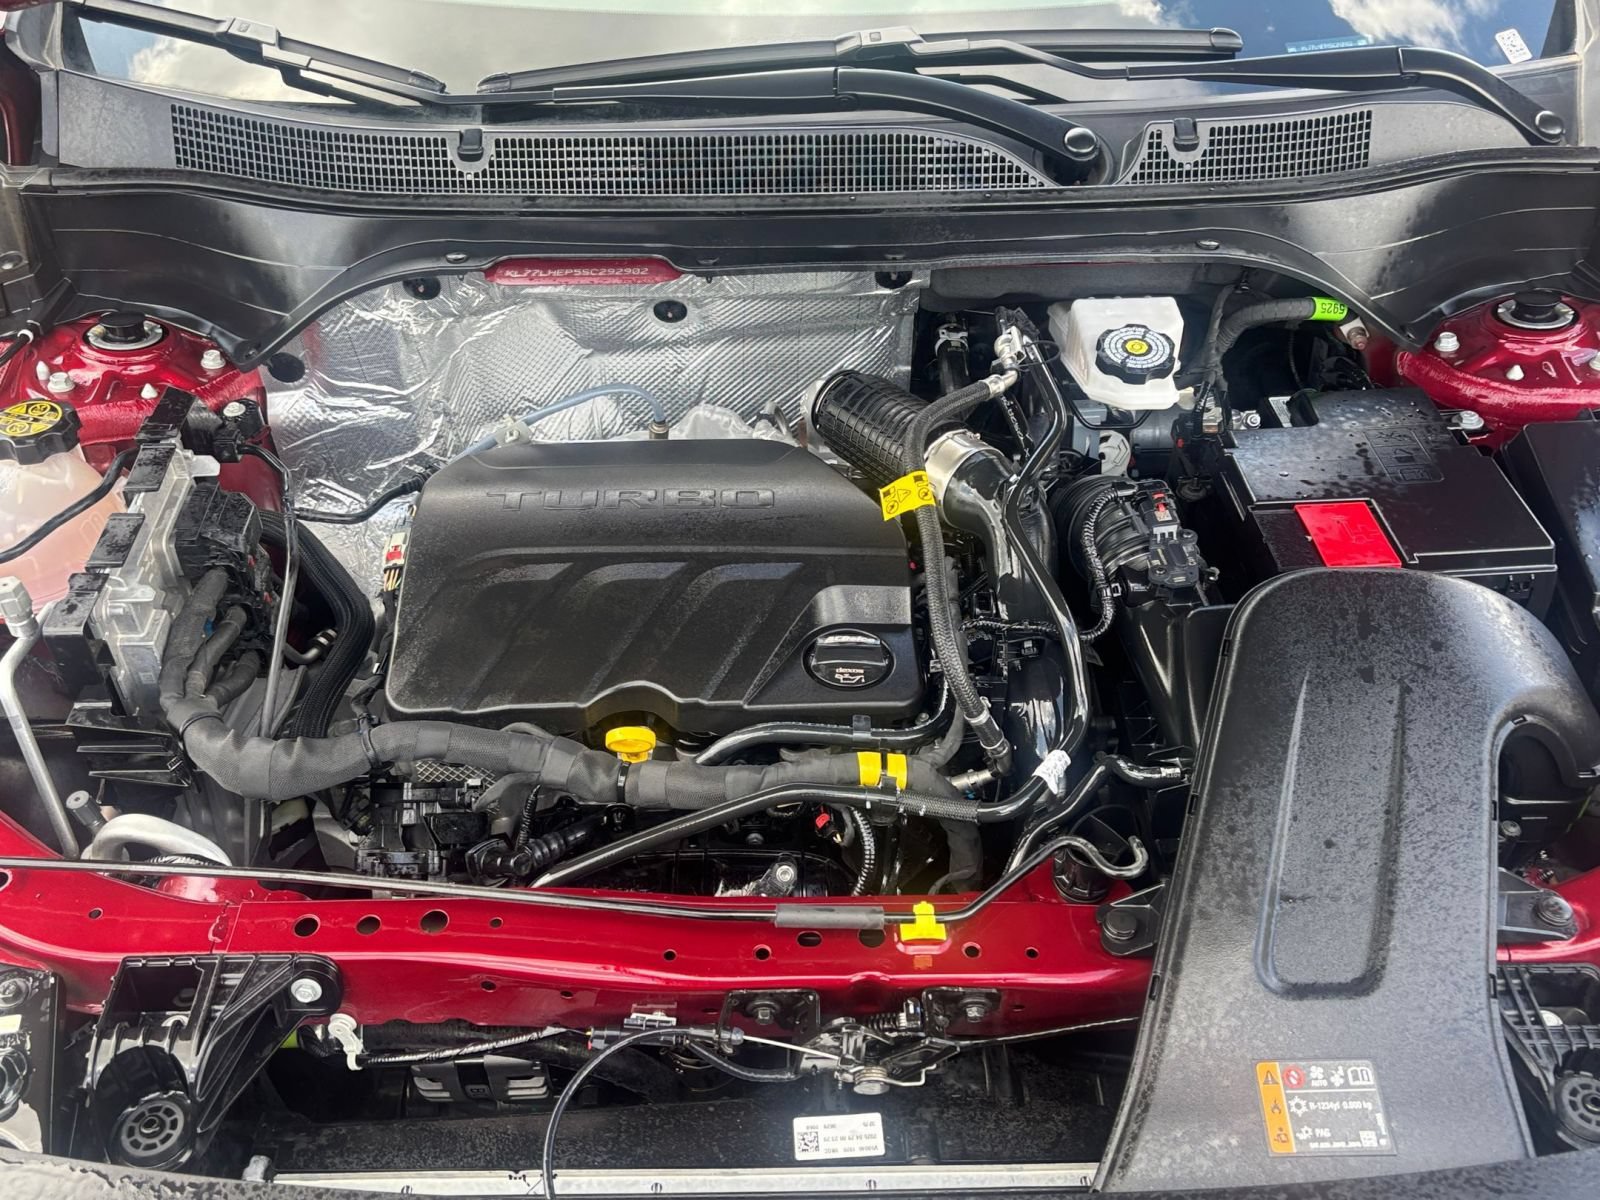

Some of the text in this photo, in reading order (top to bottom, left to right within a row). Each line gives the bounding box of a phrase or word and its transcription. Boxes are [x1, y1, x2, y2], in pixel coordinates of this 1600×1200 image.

[504, 267, 649, 278] KL77LHEP5SC292902
[1320, 302, 1345, 314] 5925
[487, 488, 775, 511] TURBO
